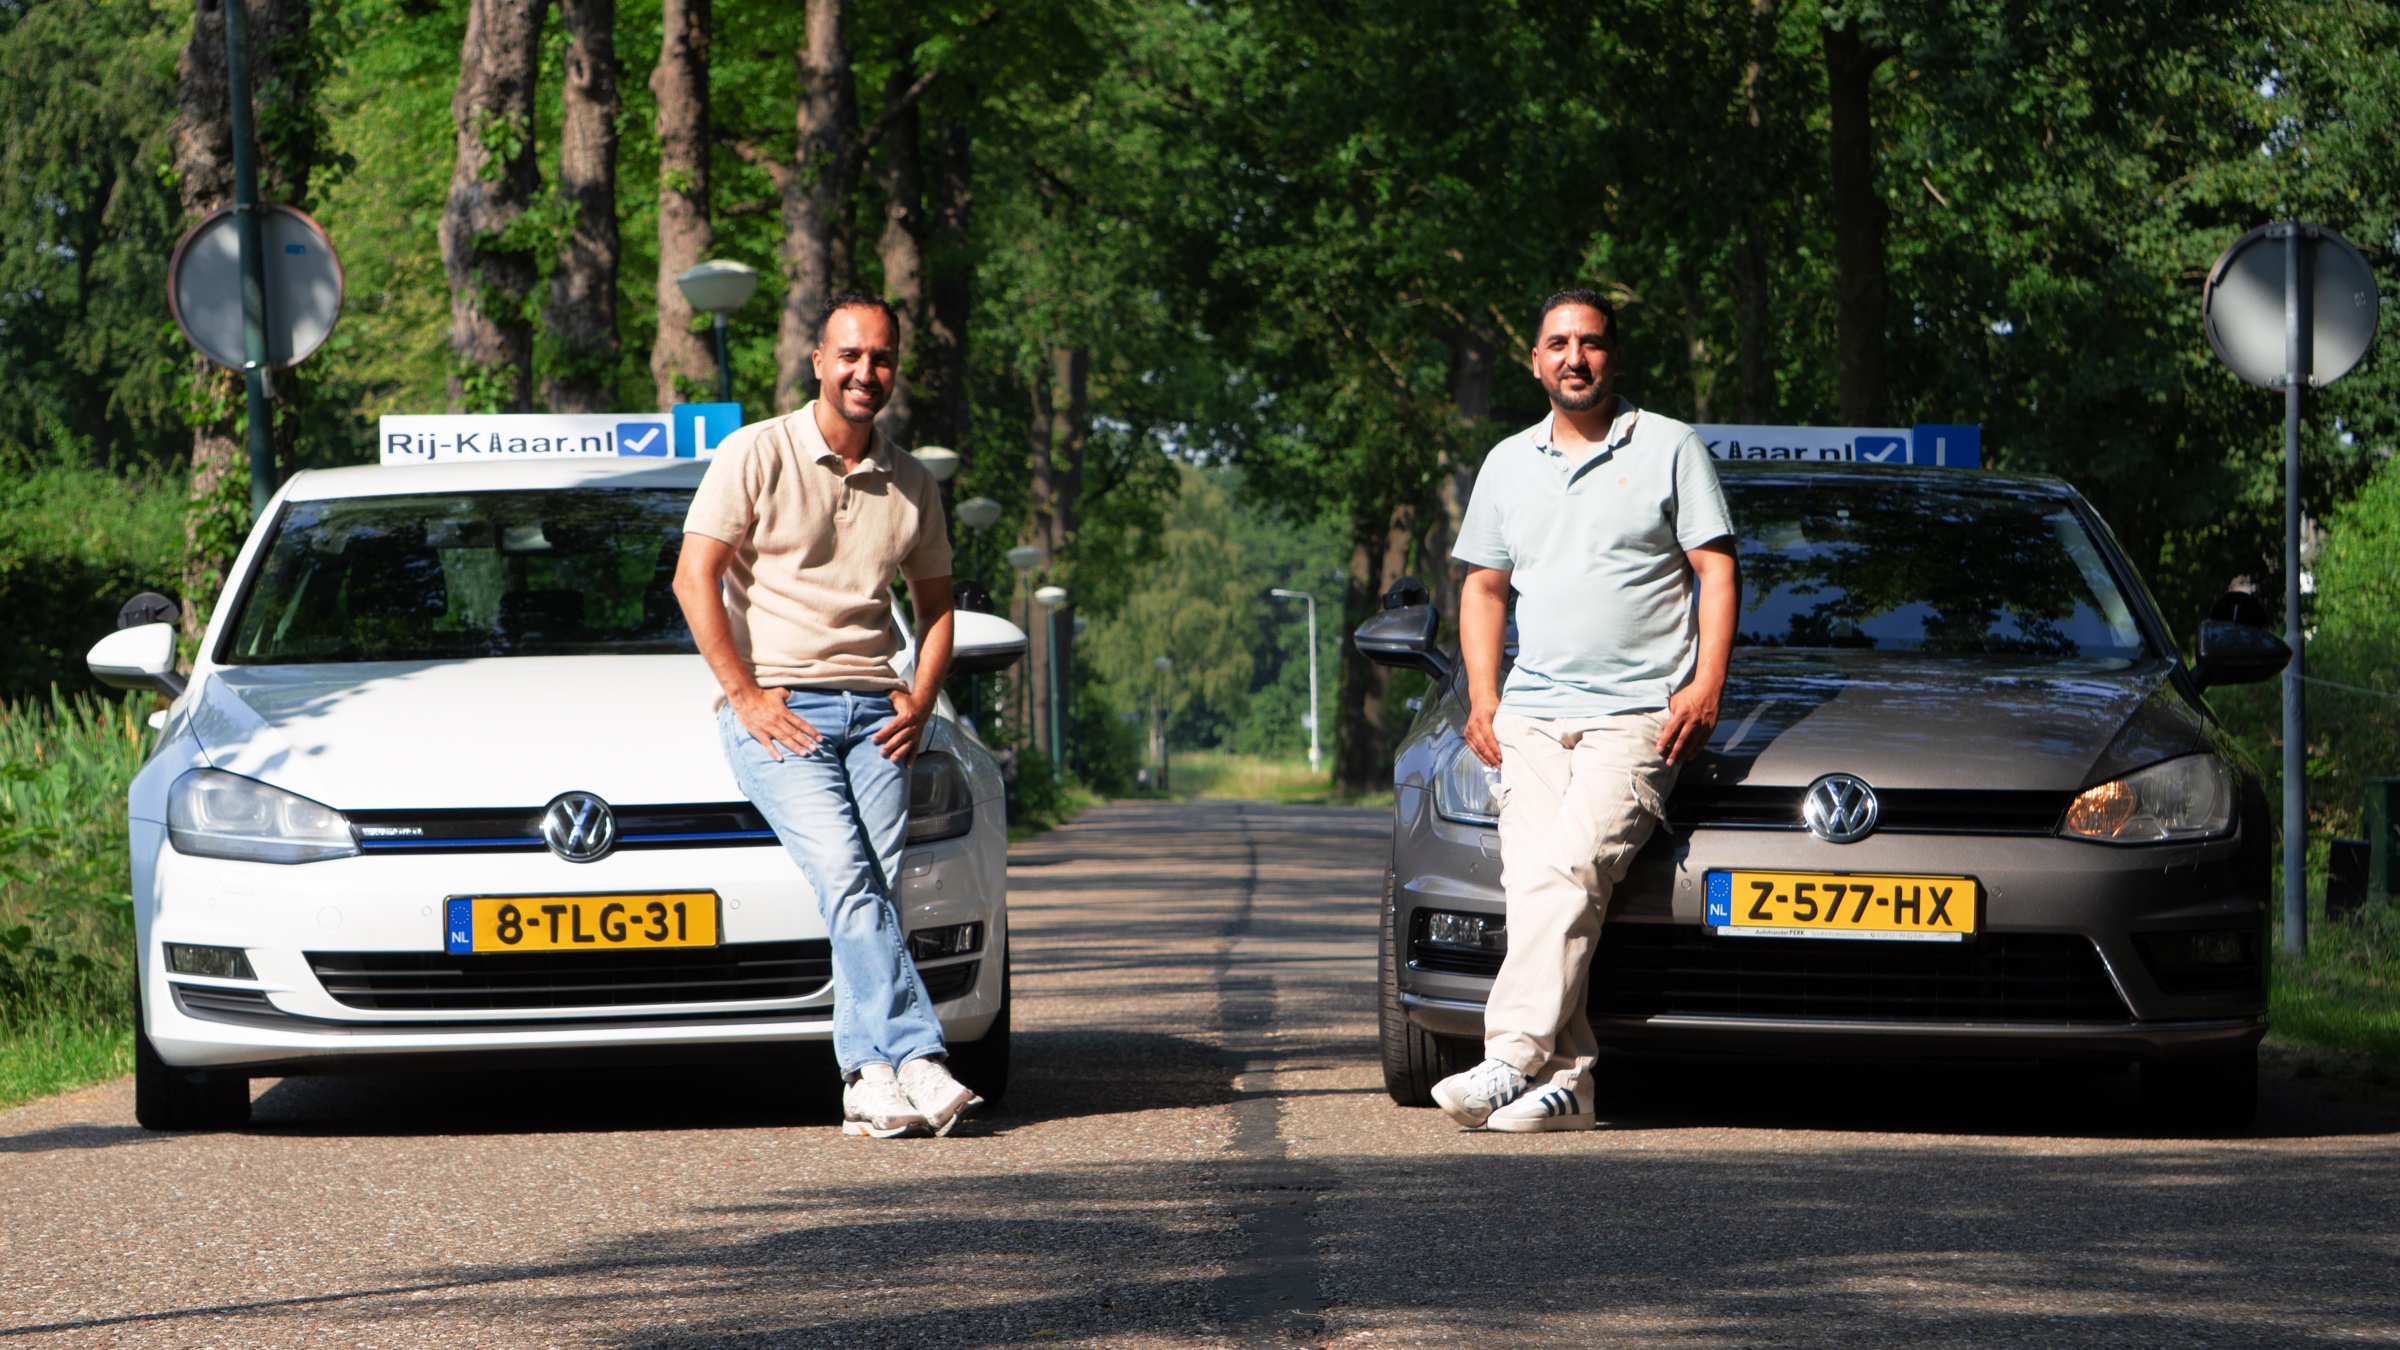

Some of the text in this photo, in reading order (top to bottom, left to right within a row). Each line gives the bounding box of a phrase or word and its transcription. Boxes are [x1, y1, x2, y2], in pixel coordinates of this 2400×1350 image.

[694, 416, 721, 460] L
[497, 902, 686, 945] 8-TLG-31
[1710, 904, 1727, 916] NL
[1748, 881, 1953, 926] Z-577-HX
[451, 931, 469, 943] NL
